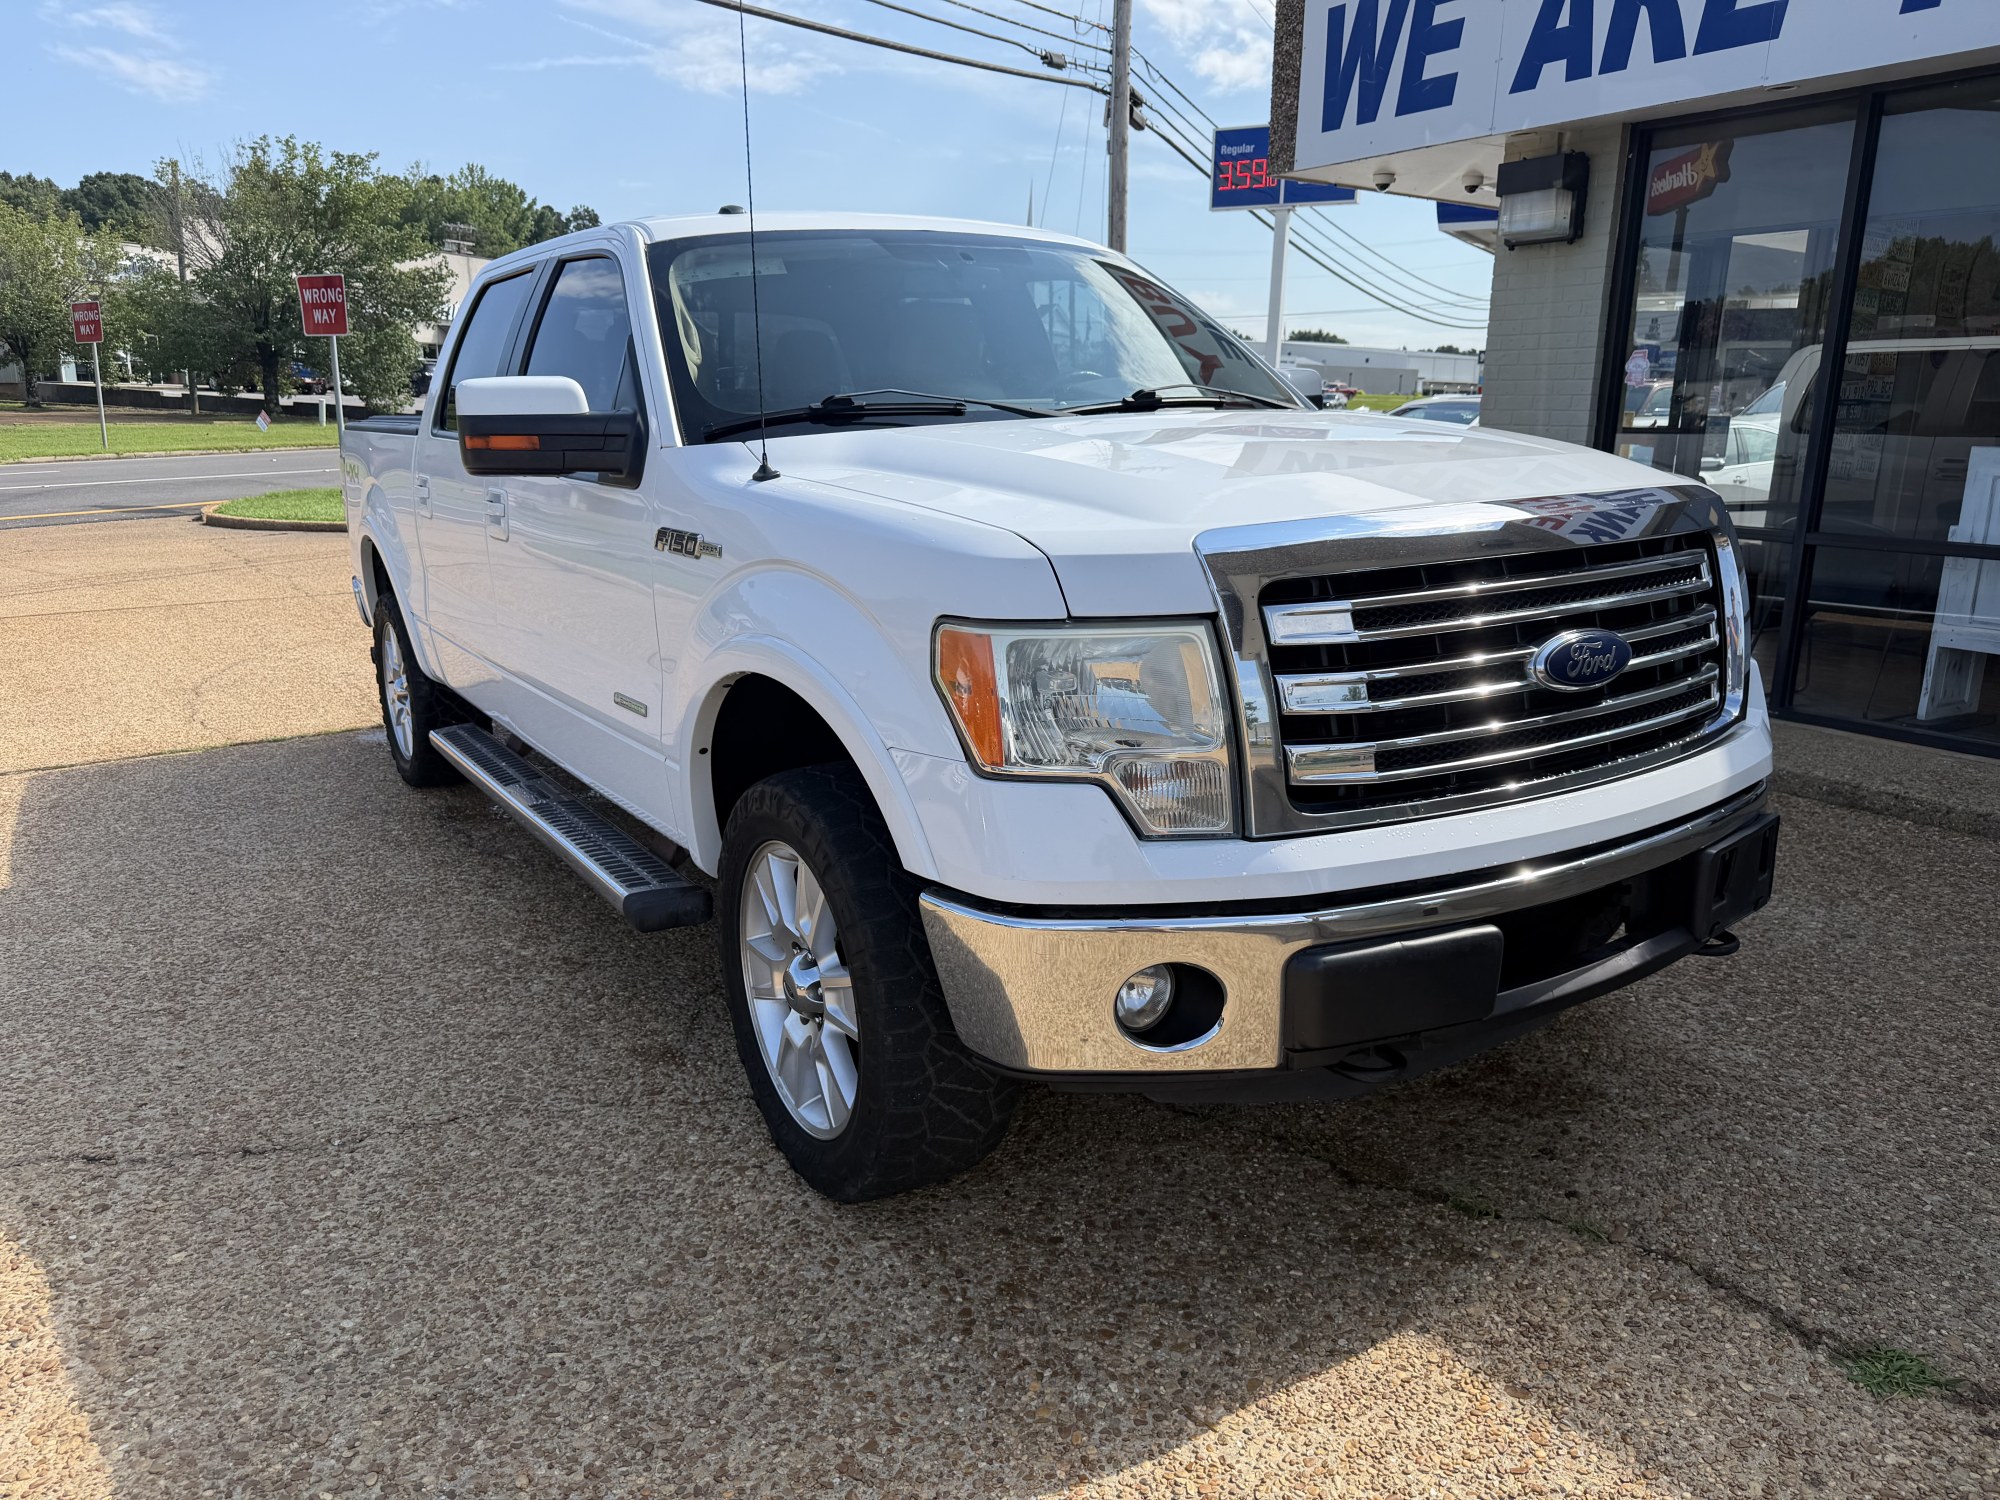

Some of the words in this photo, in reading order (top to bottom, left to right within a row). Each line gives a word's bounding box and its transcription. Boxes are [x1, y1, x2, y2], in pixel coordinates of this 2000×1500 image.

[1321, 0, 1466, 132] WE
[1221, 143, 1255, 156] Regular
[303, 287, 343, 304] WRONG
[73, 310, 99, 322] WRONG
[312, 308, 337, 324] WAY
[79, 324, 95, 336] WAY
[1566, 641, 1617, 678] Ford
